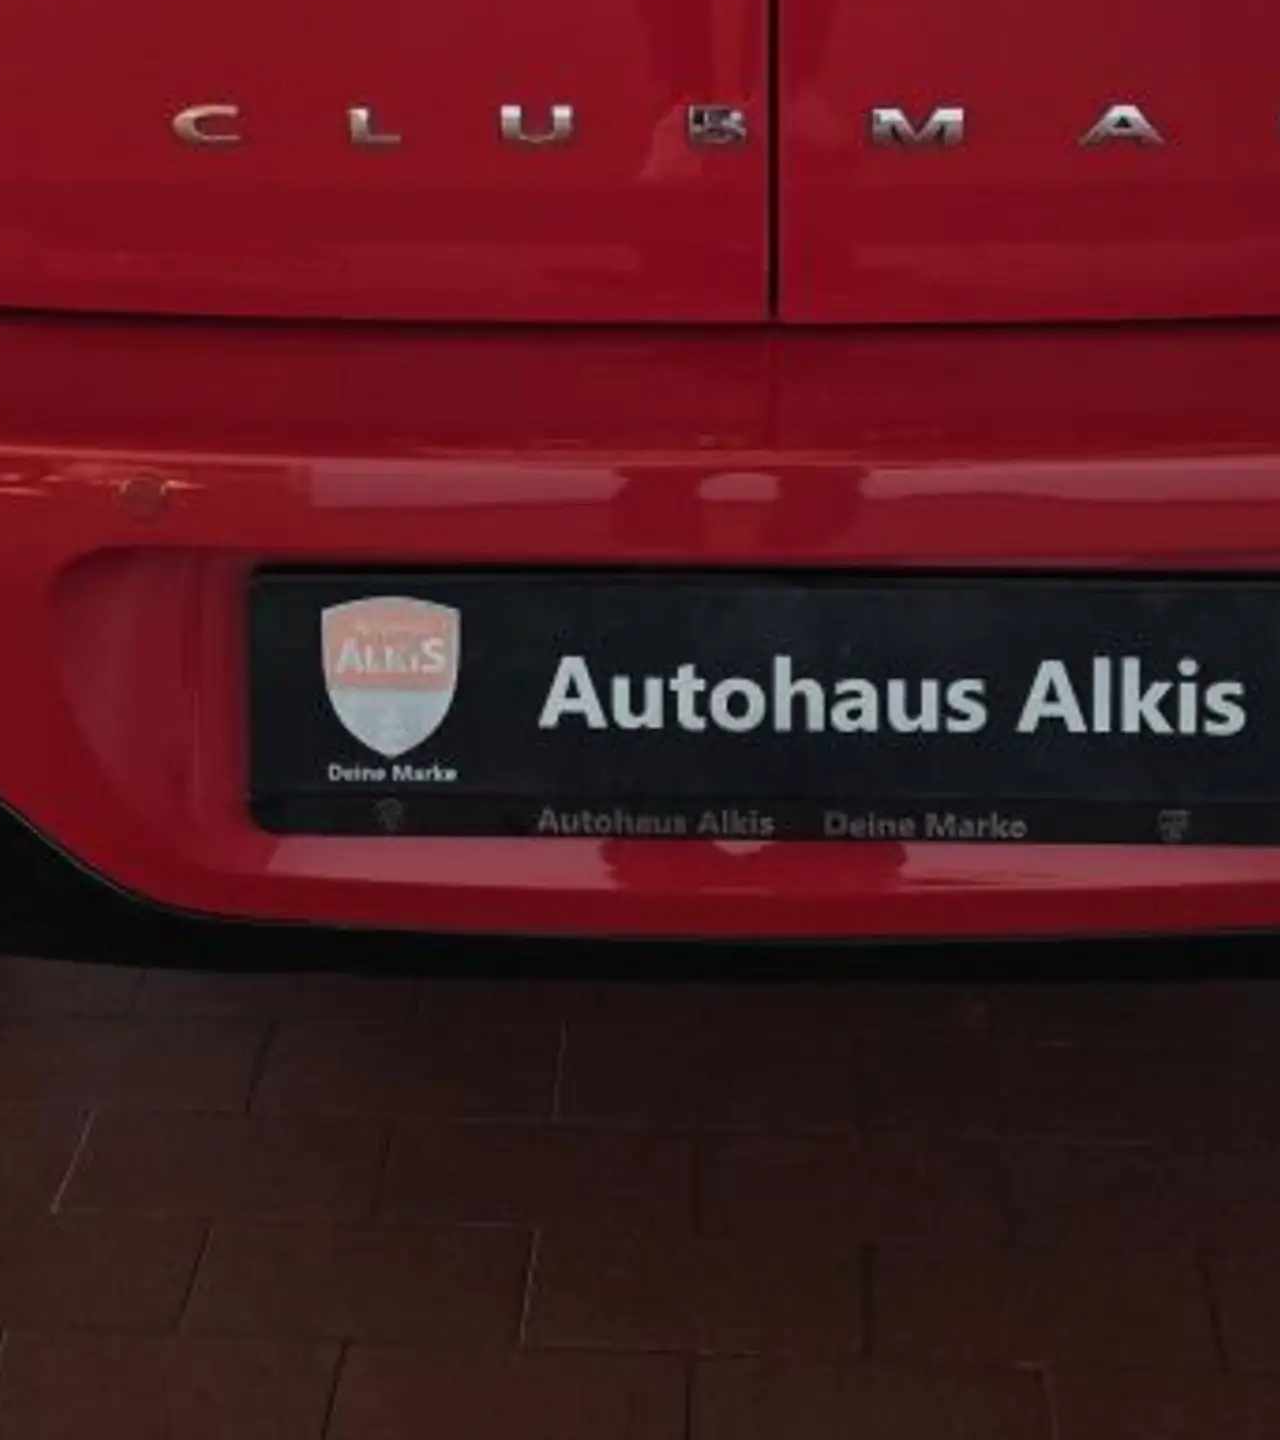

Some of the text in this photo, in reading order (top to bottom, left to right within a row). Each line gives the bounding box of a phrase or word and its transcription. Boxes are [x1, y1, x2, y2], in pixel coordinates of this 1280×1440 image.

[538, 655, 1247, 736] Autohaus Alkis
[327, 762, 459, 783] Deine Marke
[537, 807, 1028, 840] Autohaus Alkis Deine Marke
